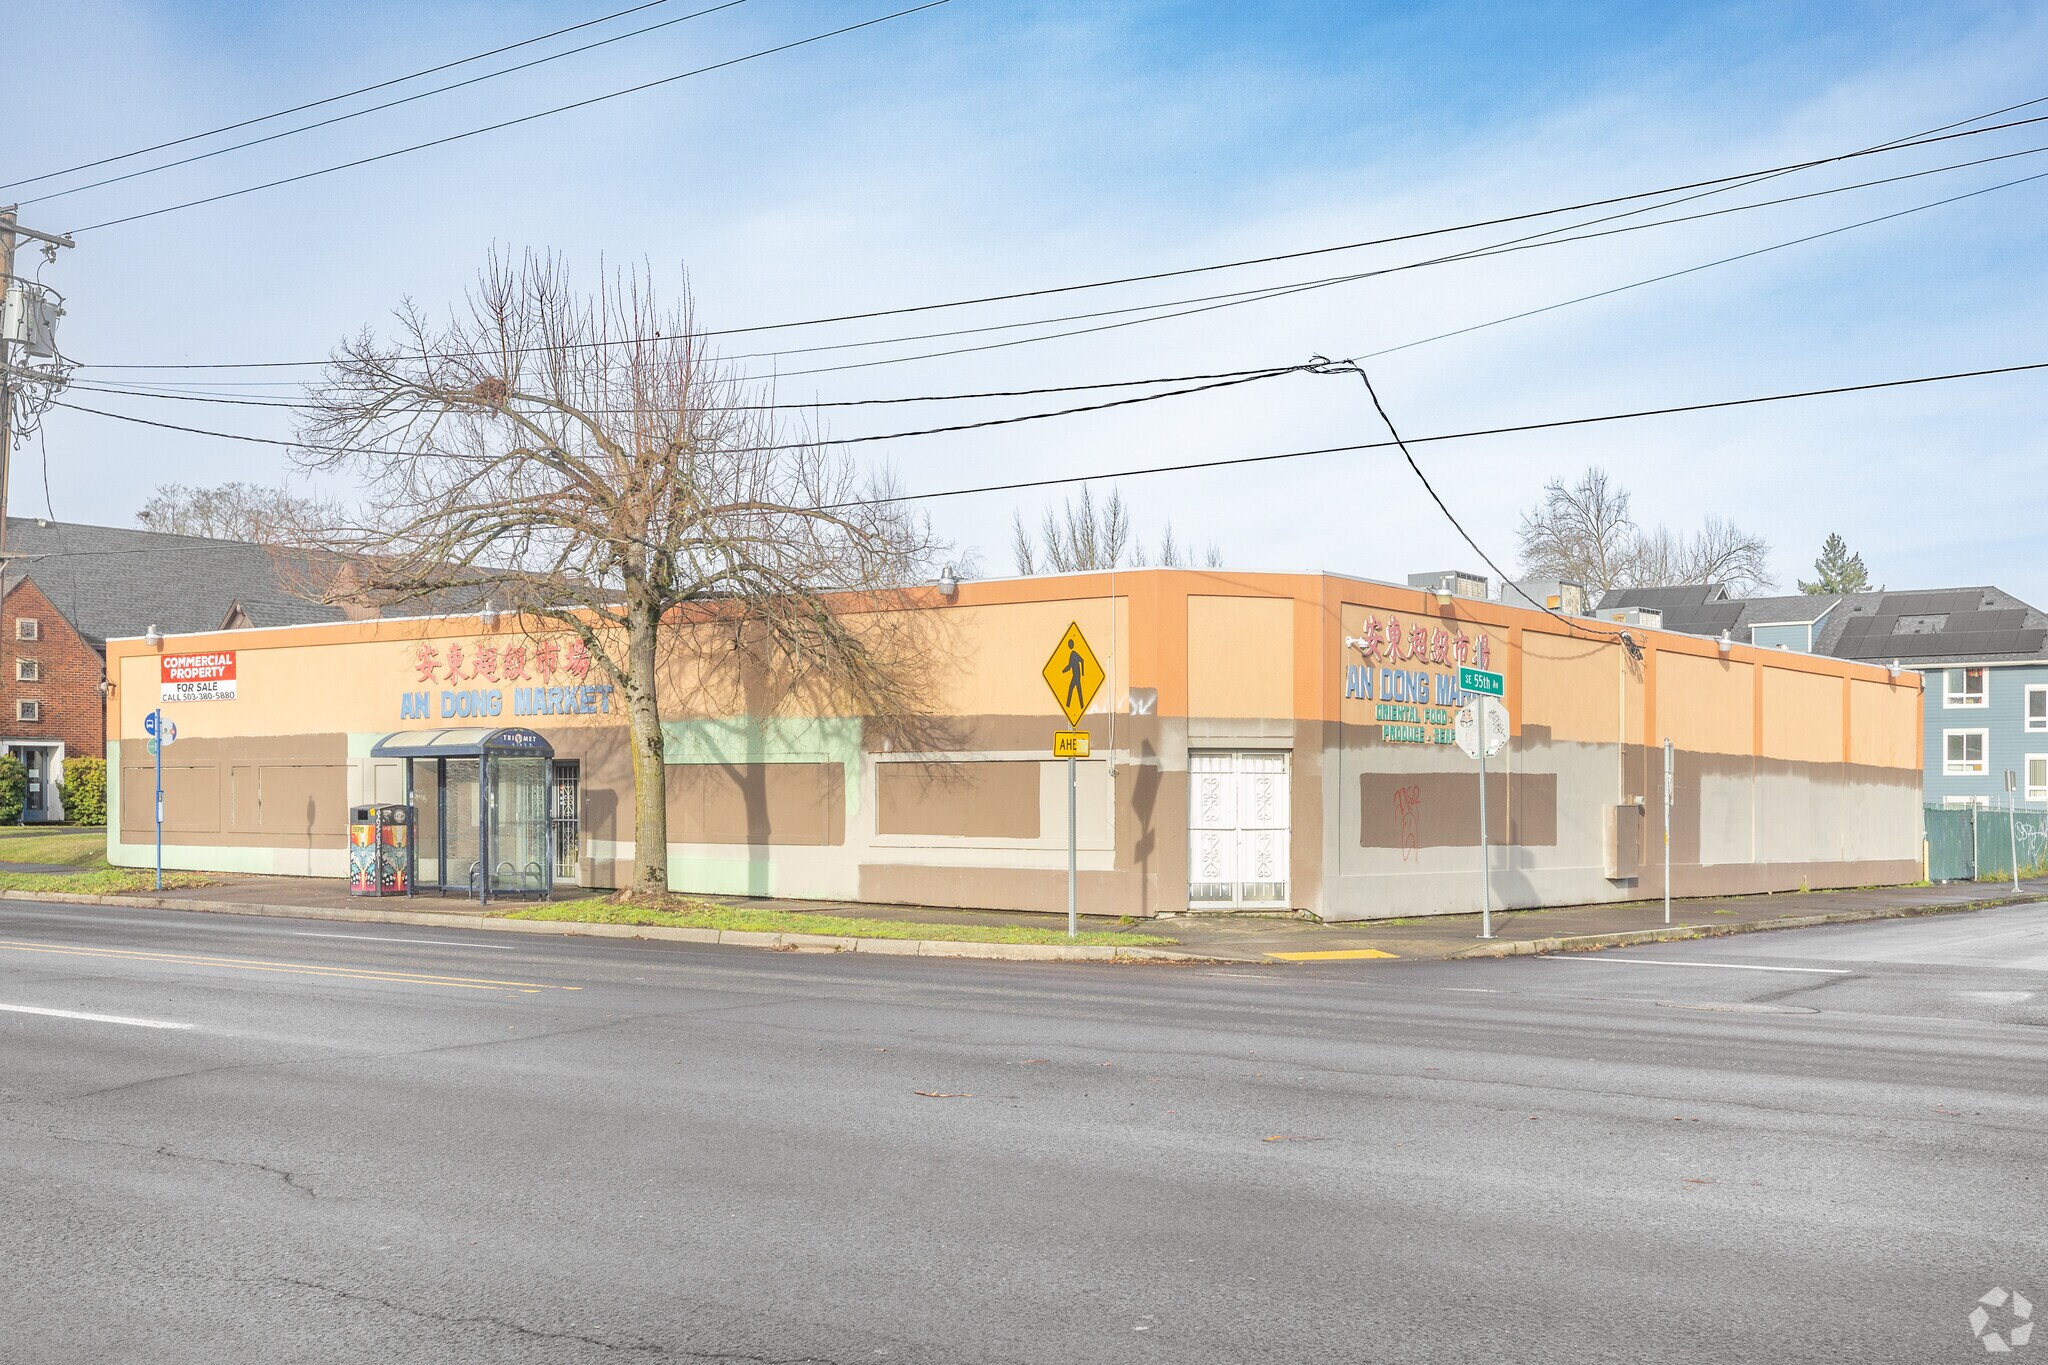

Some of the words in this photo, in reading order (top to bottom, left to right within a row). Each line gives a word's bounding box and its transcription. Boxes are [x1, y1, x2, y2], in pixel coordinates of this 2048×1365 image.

[163, 654, 233, 668] COMMERCIAL
[414, 637, 591, 686] 安東超級市場
[170, 666, 225, 679] PROPERTY
[177, 683, 194, 693] FOR
[196, 682, 218, 692] SALE
[1345, 665, 1374, 700] AN
[1379, 667, 1430, 704] DONG
[1465, 674, 1472, 685] SE
[1474, 674, 1491, 690] 55th
[162, 693, 181, 702] CALL
[182, 691, 235, 701] 503-380-5880
[400, 691, 430, 719] AN
[441, 689, 503, 718] DONG
[514, 684, 614, 716] MARKET
[1376, 704, 1421, 723] ORIENTAL
[1424, 708, 1447, 725] FOOD
[1382, 725, 1425, 743] PRODUCE
[1059, 738, 1085, 750] AHE
